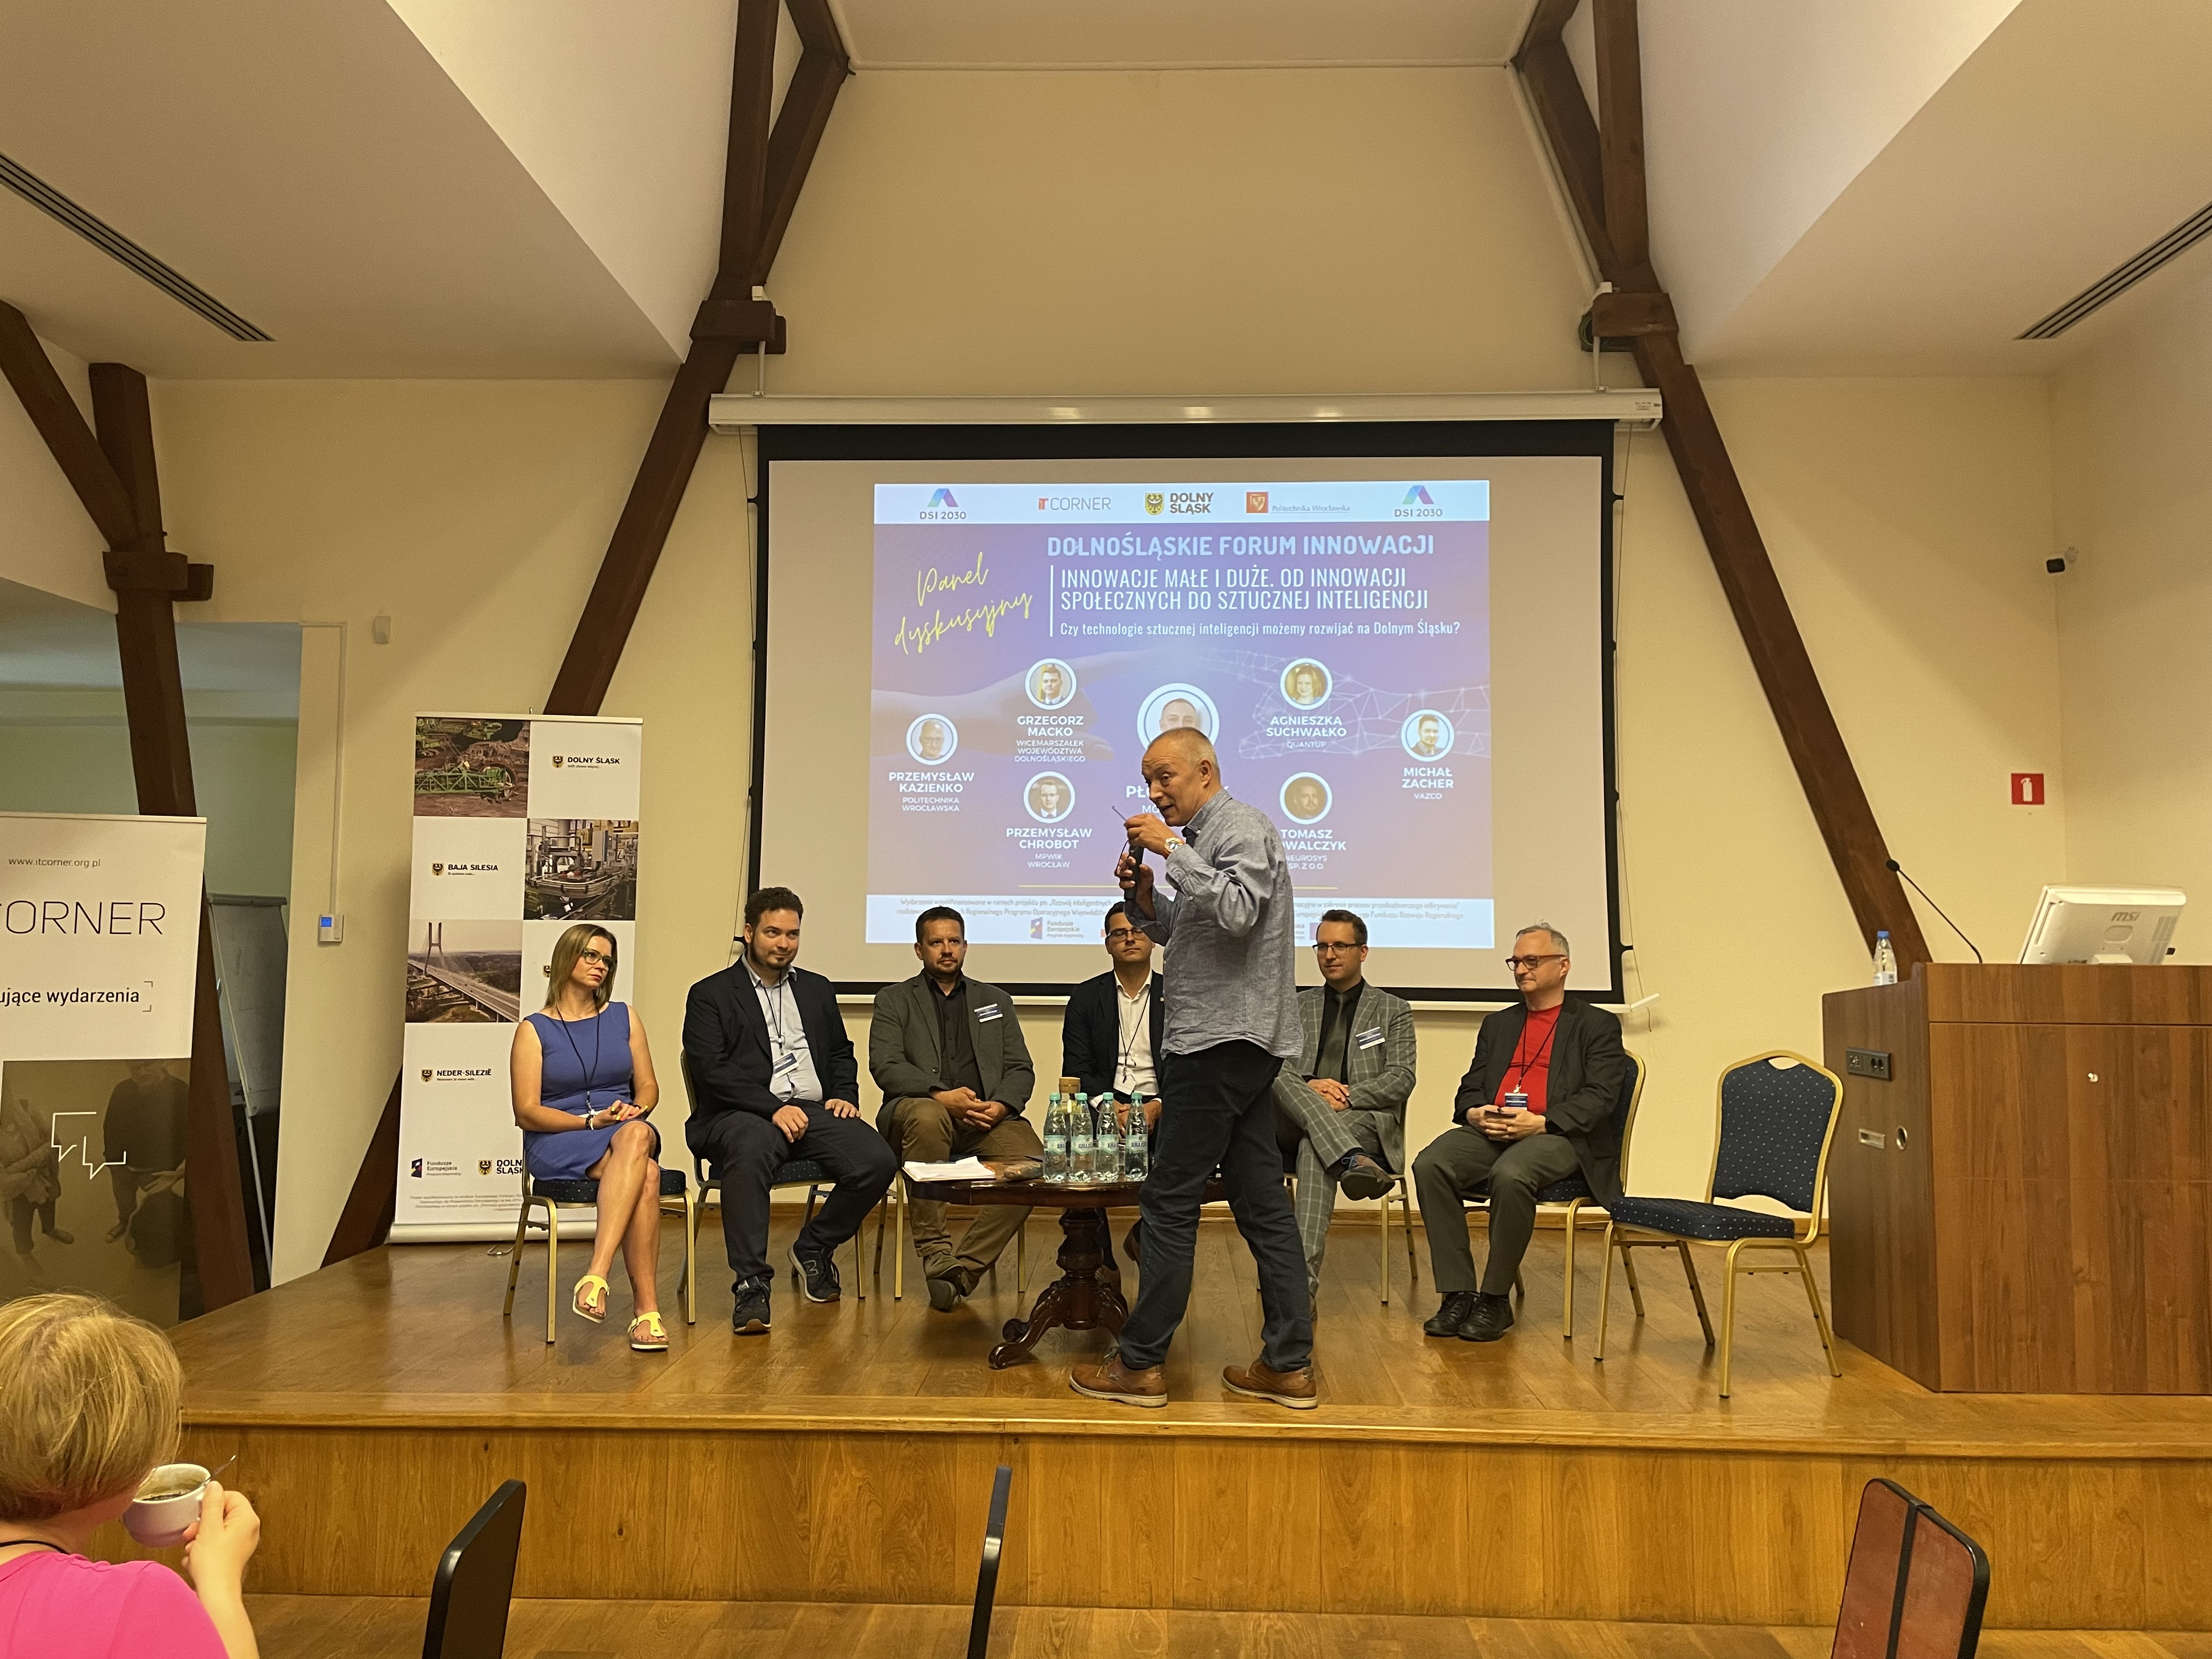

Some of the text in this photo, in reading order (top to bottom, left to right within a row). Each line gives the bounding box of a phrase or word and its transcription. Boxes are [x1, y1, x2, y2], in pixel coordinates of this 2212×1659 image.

[1170, 493, 1215, 503] DOLNY
[1051, 497, 1111, 510] CORNER
[1170, 501, 1211, 515] ŚLĄSK
[919, 511, 967, 520] DSI 2030
[1394, 509, 1443, 517] DSI 2030
[1047, 532, 1434, 561] DOLNOŚLĄSKIE FORUM INNOWACJI
[917, 551, 989, 607] Panel
[1061, 564, 1406, 588] INNOWACJE MAŁE I DUŻE. OD INNOWACJI
[1060, 590, 1428, 610] SPOŁECZNYCH DO SZTUCZNEJ INTELIGENCJI
[894, 592, 1032, 655] dyskusyjny
[1060, 618, 1460, 637] Czy technologie sztucznej inteligencji możemy rozwijać na Dolnym Śląsku?
[1017, 715, 1084, 725] GRZEGORZ
[1269, 716, 1342, 726] AGNIESZKA
[1028, 727, 1073, 737] MACKO
[1266, 727, 1347, 737] SUCHWAŁKO
[1017, 746, 1083, 755] WOJEWÓDZTWA
[595, 757, 620, 765] ŚLĄSK
[1014, 754, 1086, 764] DOLNOŚLĄSKIEGO
[888, 772, 975, 782] PRZEMYSŁAW
[1403, 767, 1453, 777] MICHAŁ
[899, 783, 963, 793] KAZIENKO
[1402, 778, 1454, 788] ZACHER
[1006, 827, 1093, 838] PRZEMYSŁAW
[1280, 829, 1333, 839] TOMASZ
[1019, 839, 1080, 849] CHROBOT
[1283, 840, 1347, 851] WALCZYK
[8, 858, 101, 868] www.itcorner.org.pl
[0, 900, 166, 935] ORNER
[46, 988, 139, 1007] wydarzenia
